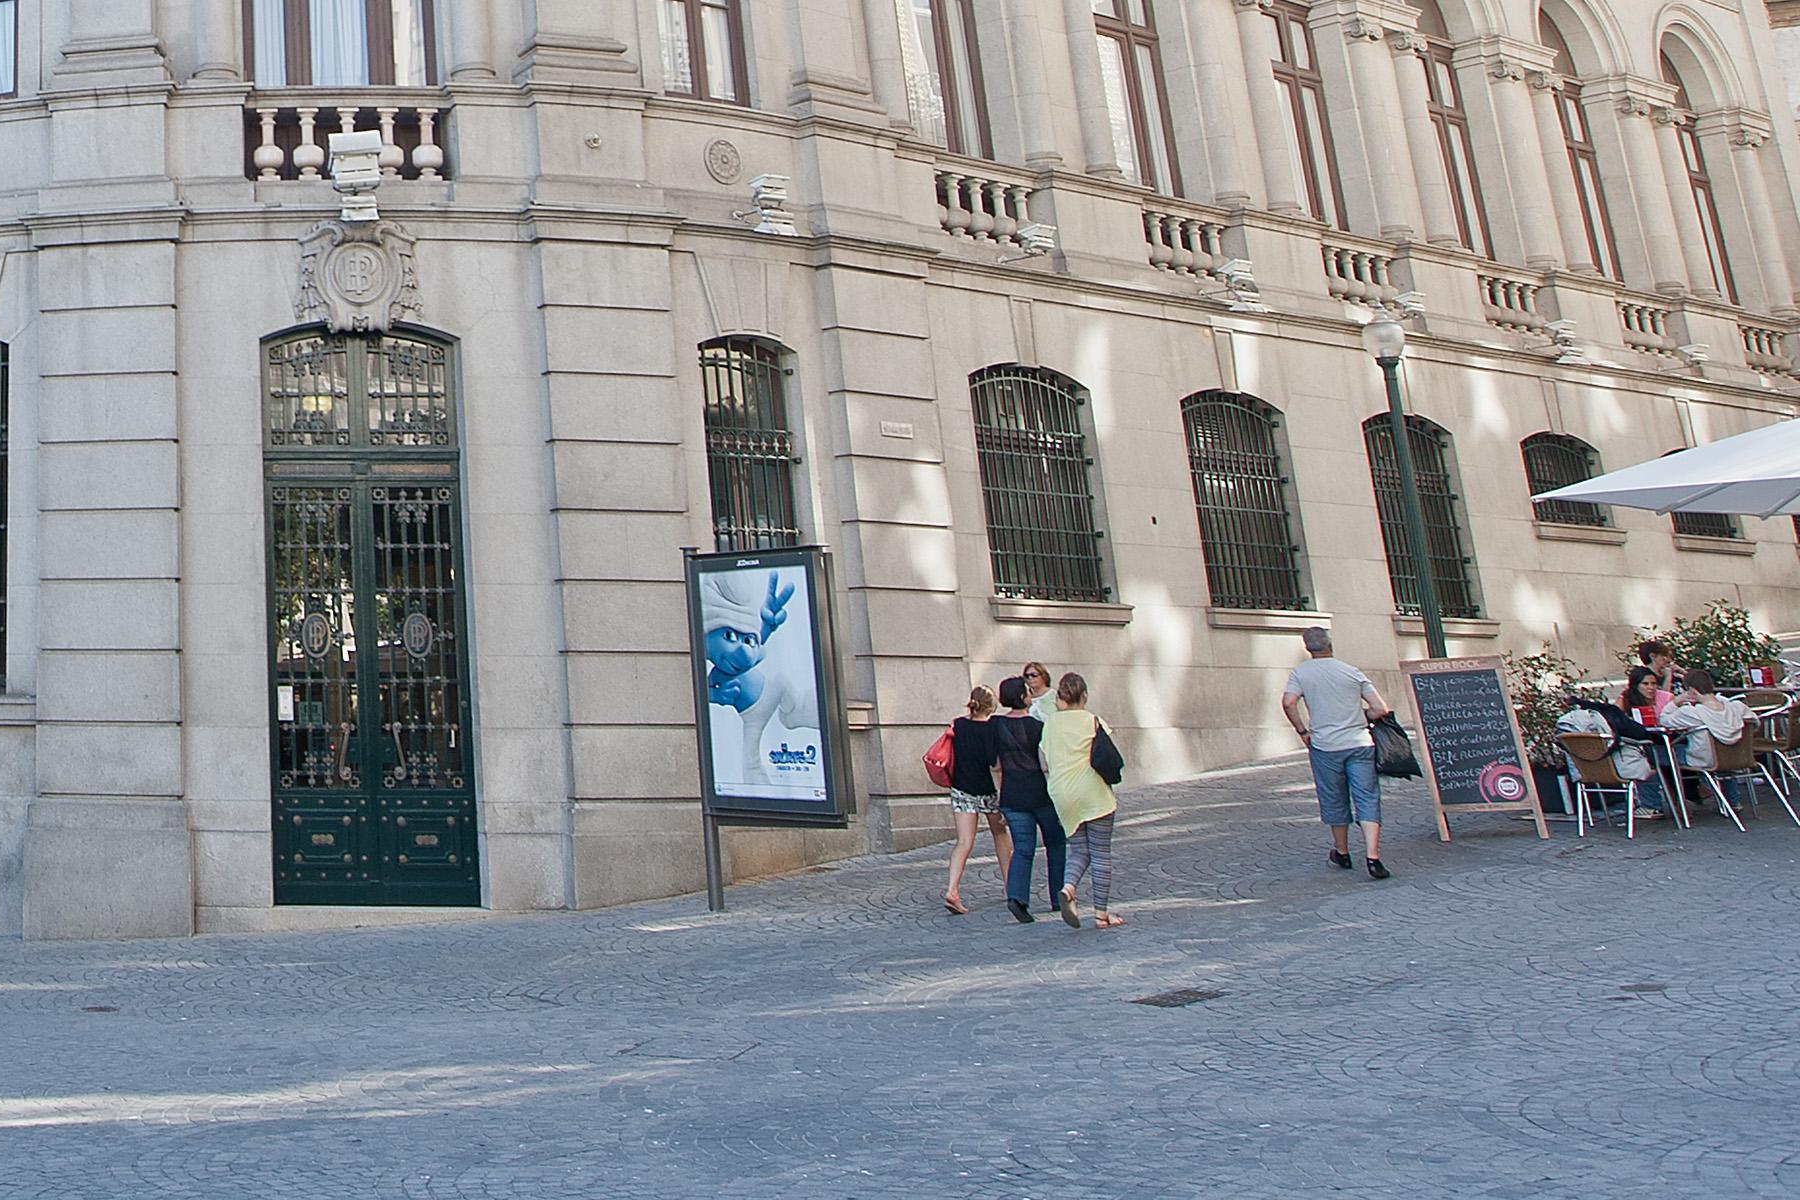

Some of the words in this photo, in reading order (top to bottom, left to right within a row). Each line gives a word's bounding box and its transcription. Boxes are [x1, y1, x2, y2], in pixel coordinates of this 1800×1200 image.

[1419, 662, 1451, 670] SUPER
[1452, 660, 1481, 669] BOCK
[806, 745, 816, 764] 2
